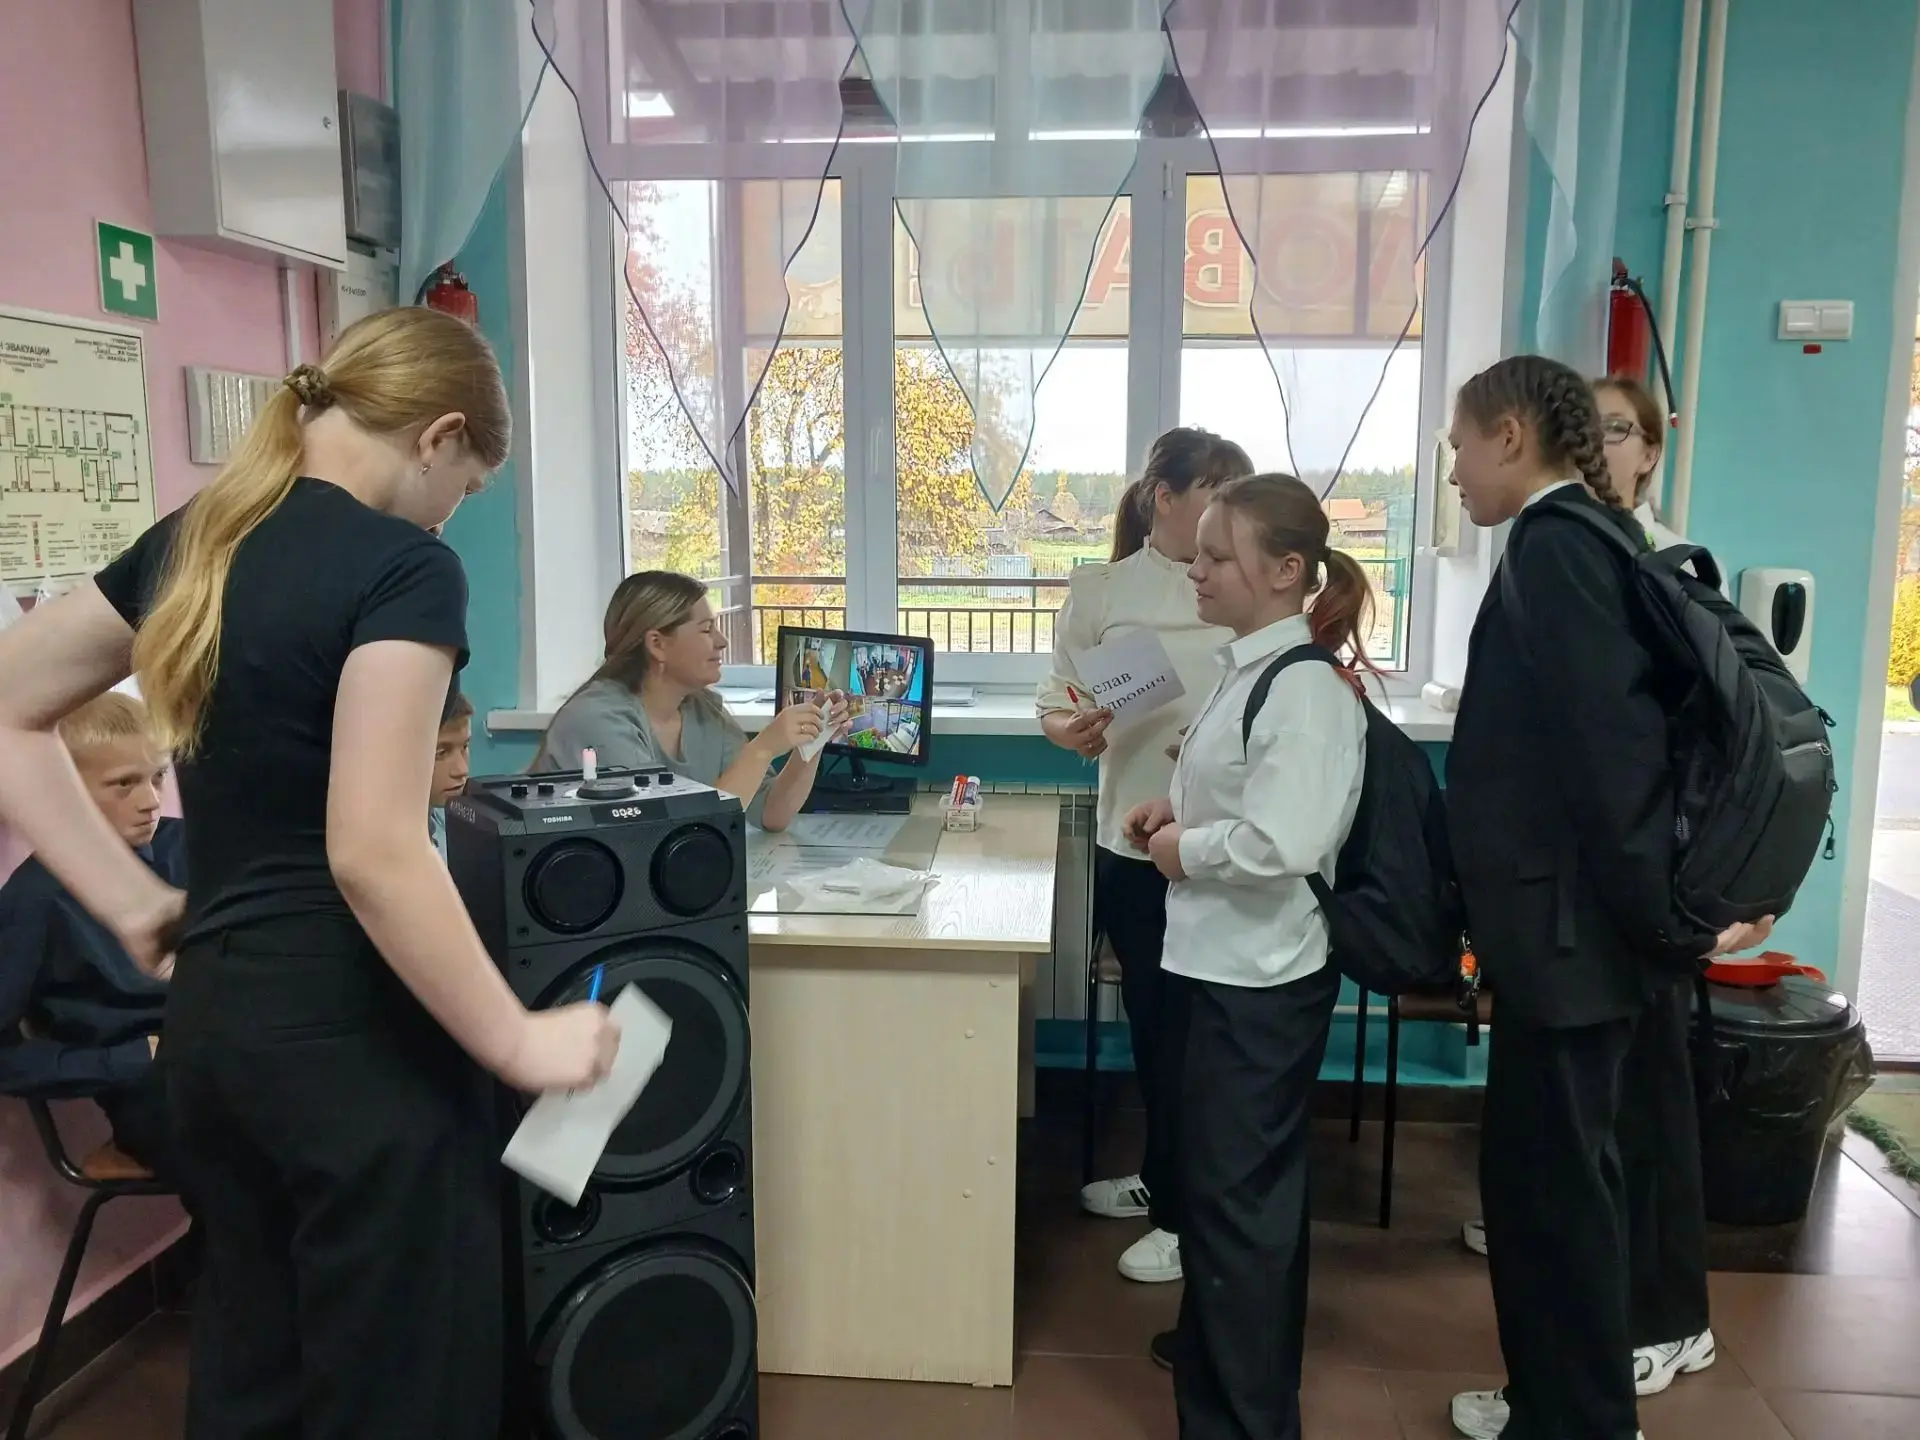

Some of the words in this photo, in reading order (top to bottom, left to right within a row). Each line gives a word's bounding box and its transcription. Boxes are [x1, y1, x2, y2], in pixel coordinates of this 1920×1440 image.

[4, 342, 50, 356] ЭВАКУАЦИИ
[1091, 672, 1132, 695] слав
[542, 815, 573, 824] TOSHIBA
